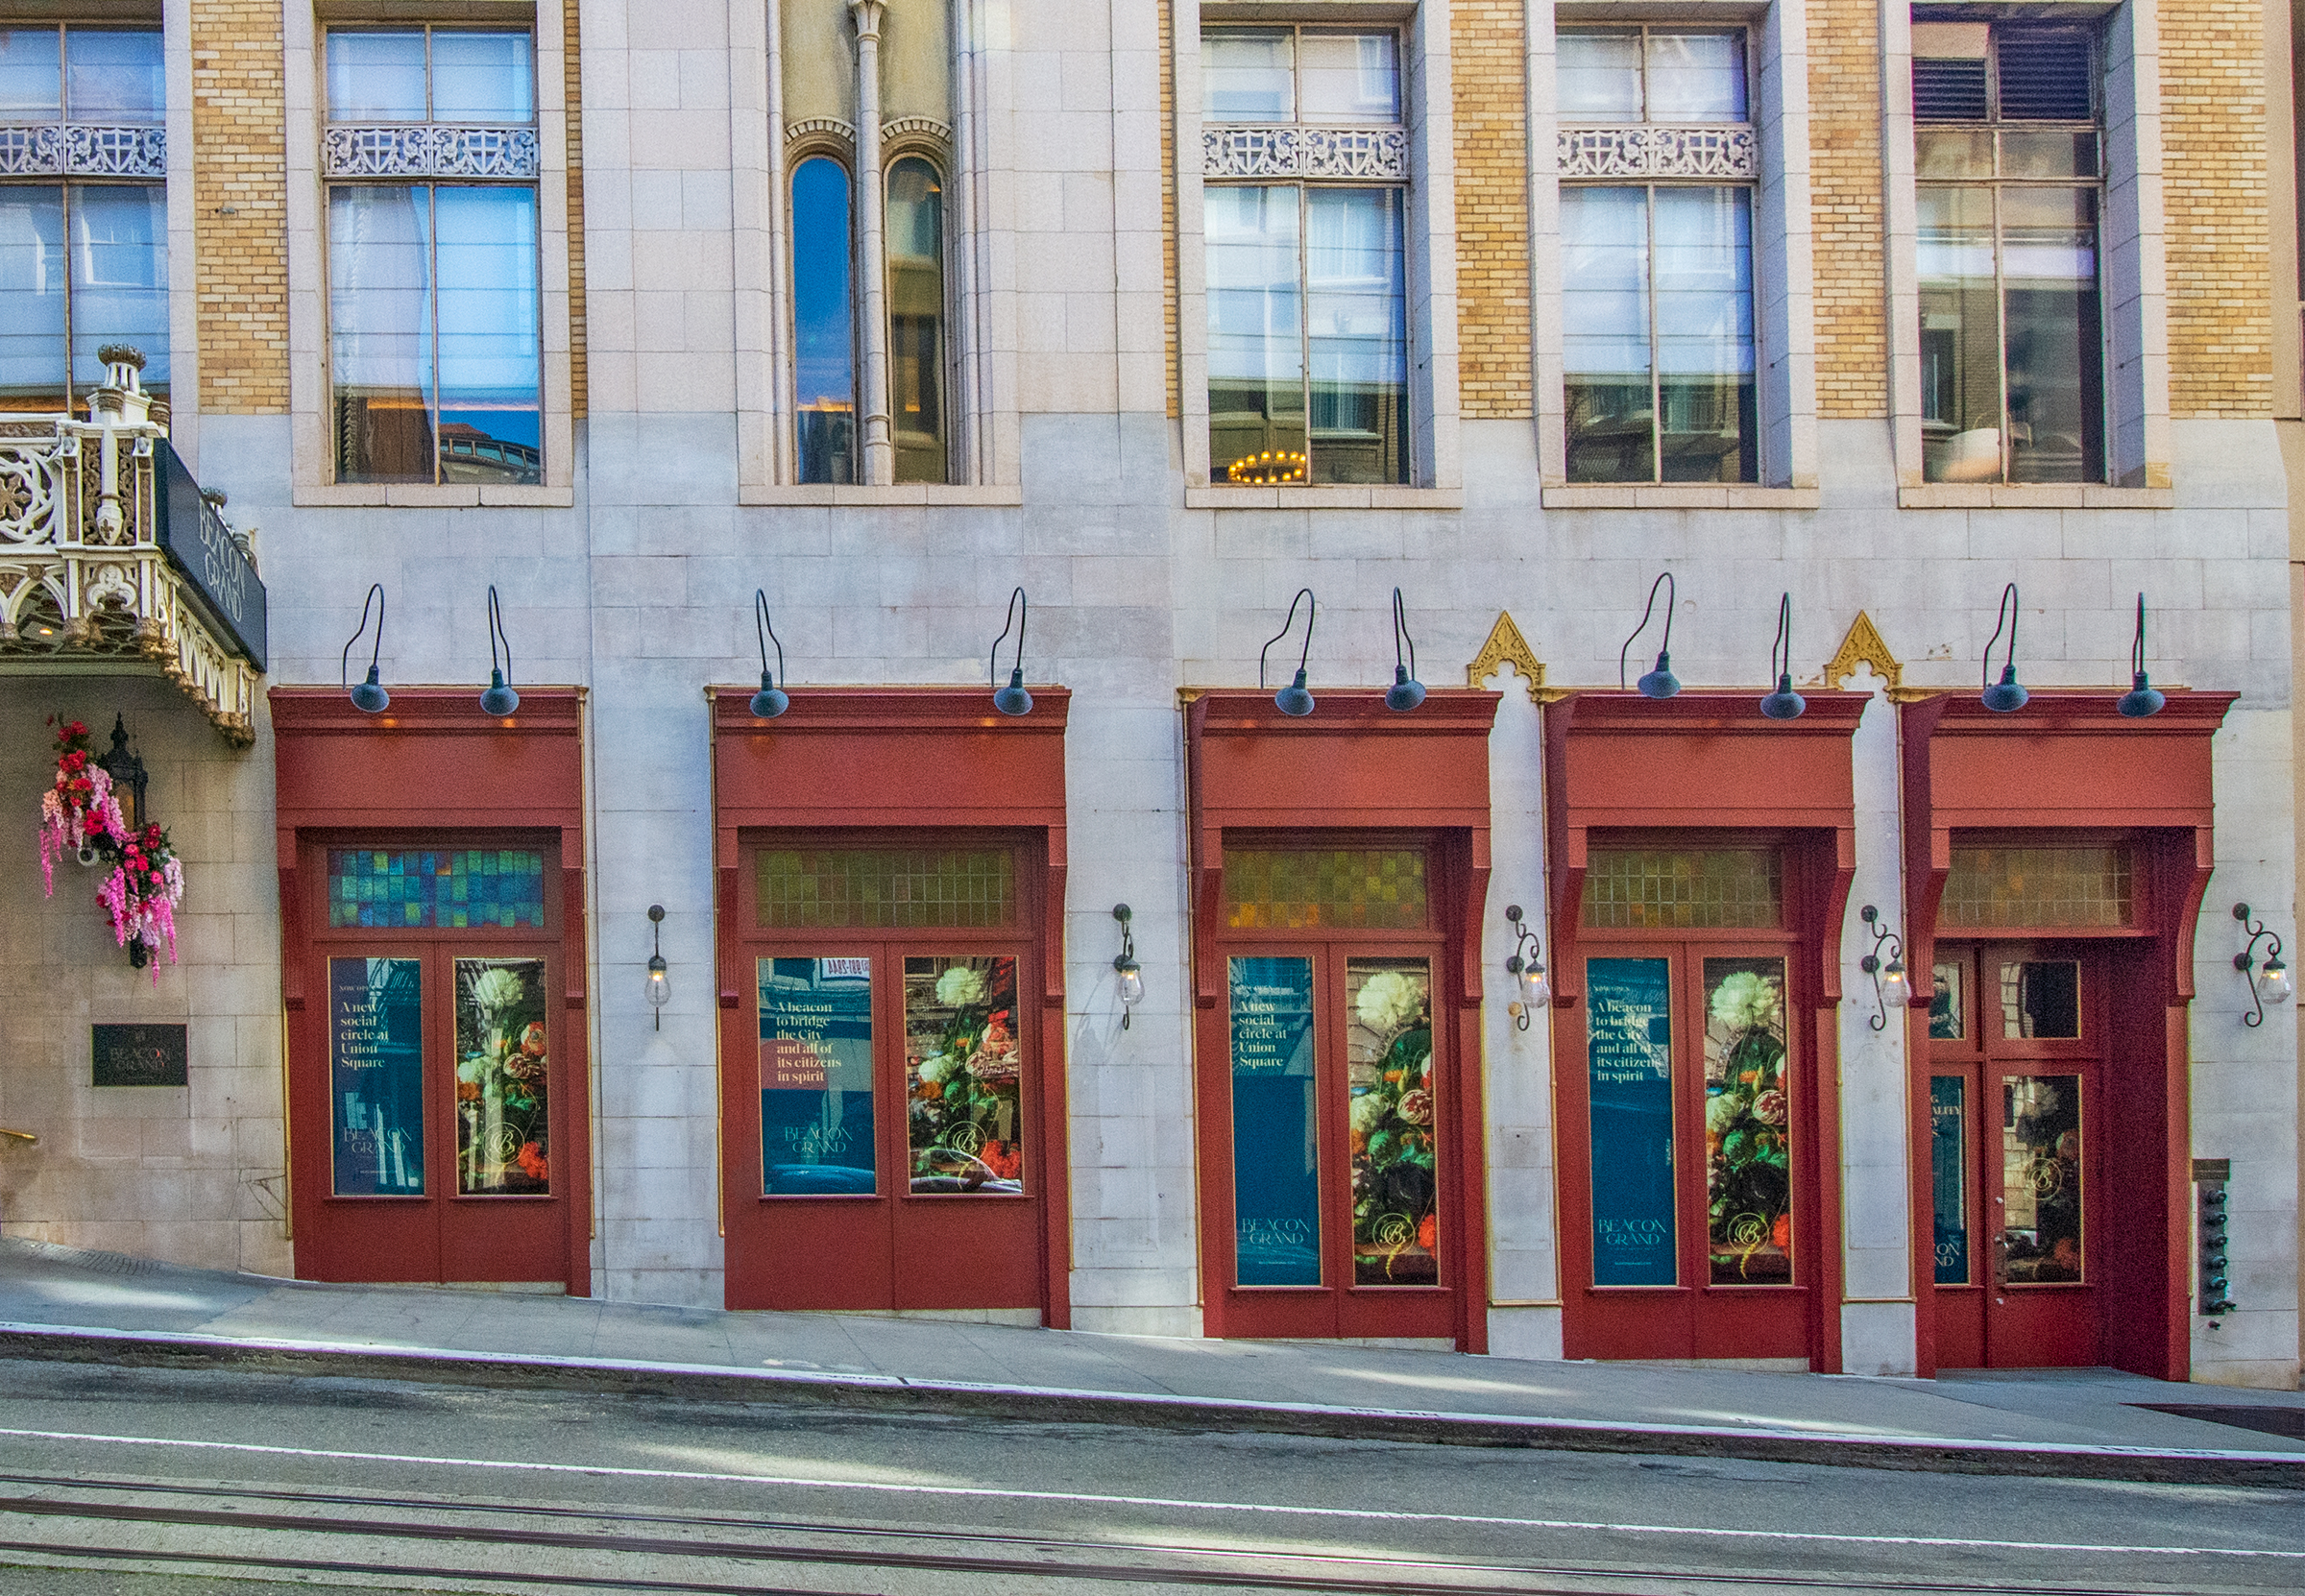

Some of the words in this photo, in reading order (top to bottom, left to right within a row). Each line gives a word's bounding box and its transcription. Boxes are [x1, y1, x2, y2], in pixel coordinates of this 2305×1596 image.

[199, 497, 245, 600] BEACON
[205, 551, 242, 623] GRAND
[340, 1002, 351, 1013] A
[352, 1004, 377, 1013] new
[775, 1002, 786, 1013] A
[788, 1002, 833, 1013] beacon
[1239, 1001, 1249, 1012] A
[1250, 1003, 1275, 1012] new
[1595, 1002, 1605, 1013] A
[1607, 1002, 1652, 1013] beacon
[340, 1015, 377, 1027] social
[776, 1016, 789, 1027] to
[790, 1015, 831, 1029] bridge
[1239, 1014, 1274, 1026] social
[1595, 1017, 1608, 1027] to
[1610, 1015, 1649, 1028] bridge
[340, 1028, 375, 1040] circle
[376, 1030, 389, 1040] at
[776, 1028, 796, 1041] the
[798, 1028, 824, 1041] City
[1239, 1028, 1274, 1039] circle
[1275, 1028, 1287, 1039] at
[1595, 1028, 1616, 1040] the
[341, 1042, 378, 1054] Union
[776, 1043, 801, 1054] and
[803, 1042, 818, 1054] all
[820, 1042, 834, 1054] of
[1239, 1041, 1276, 1052] Union
[1596, 1043, 1620, 1053] and
[1622, 1043, 1638, 1053] all
[341, 1057, 385, 1071] Square
[777, 1056, 792, 1068] its
[794, 1056, 842, 1068] citizens
[1239, 1055, 1284, 1069] Square
[1596, 1056, 1613, 1068] its
[1614, 1056, 1662, 1068] citizens
[777, 1071, 789, 1082] in
[791, 1071, 824, 1085] spirit
[1597, 1070, 1610, 1081] in
[1612, 1070, 1644, 1084] spirit
[785, 1126, 854, 1142] BEACON
[792, 1140, 847, 1153] GRAND
[1242, 1218, 1311, 1233] BEACON
[1598, 1219, 1667, 1233] BEACON
[1250, 1233, 1304, 1245] GRAND
[1606, 1233, 1661, 1245] GRAND
